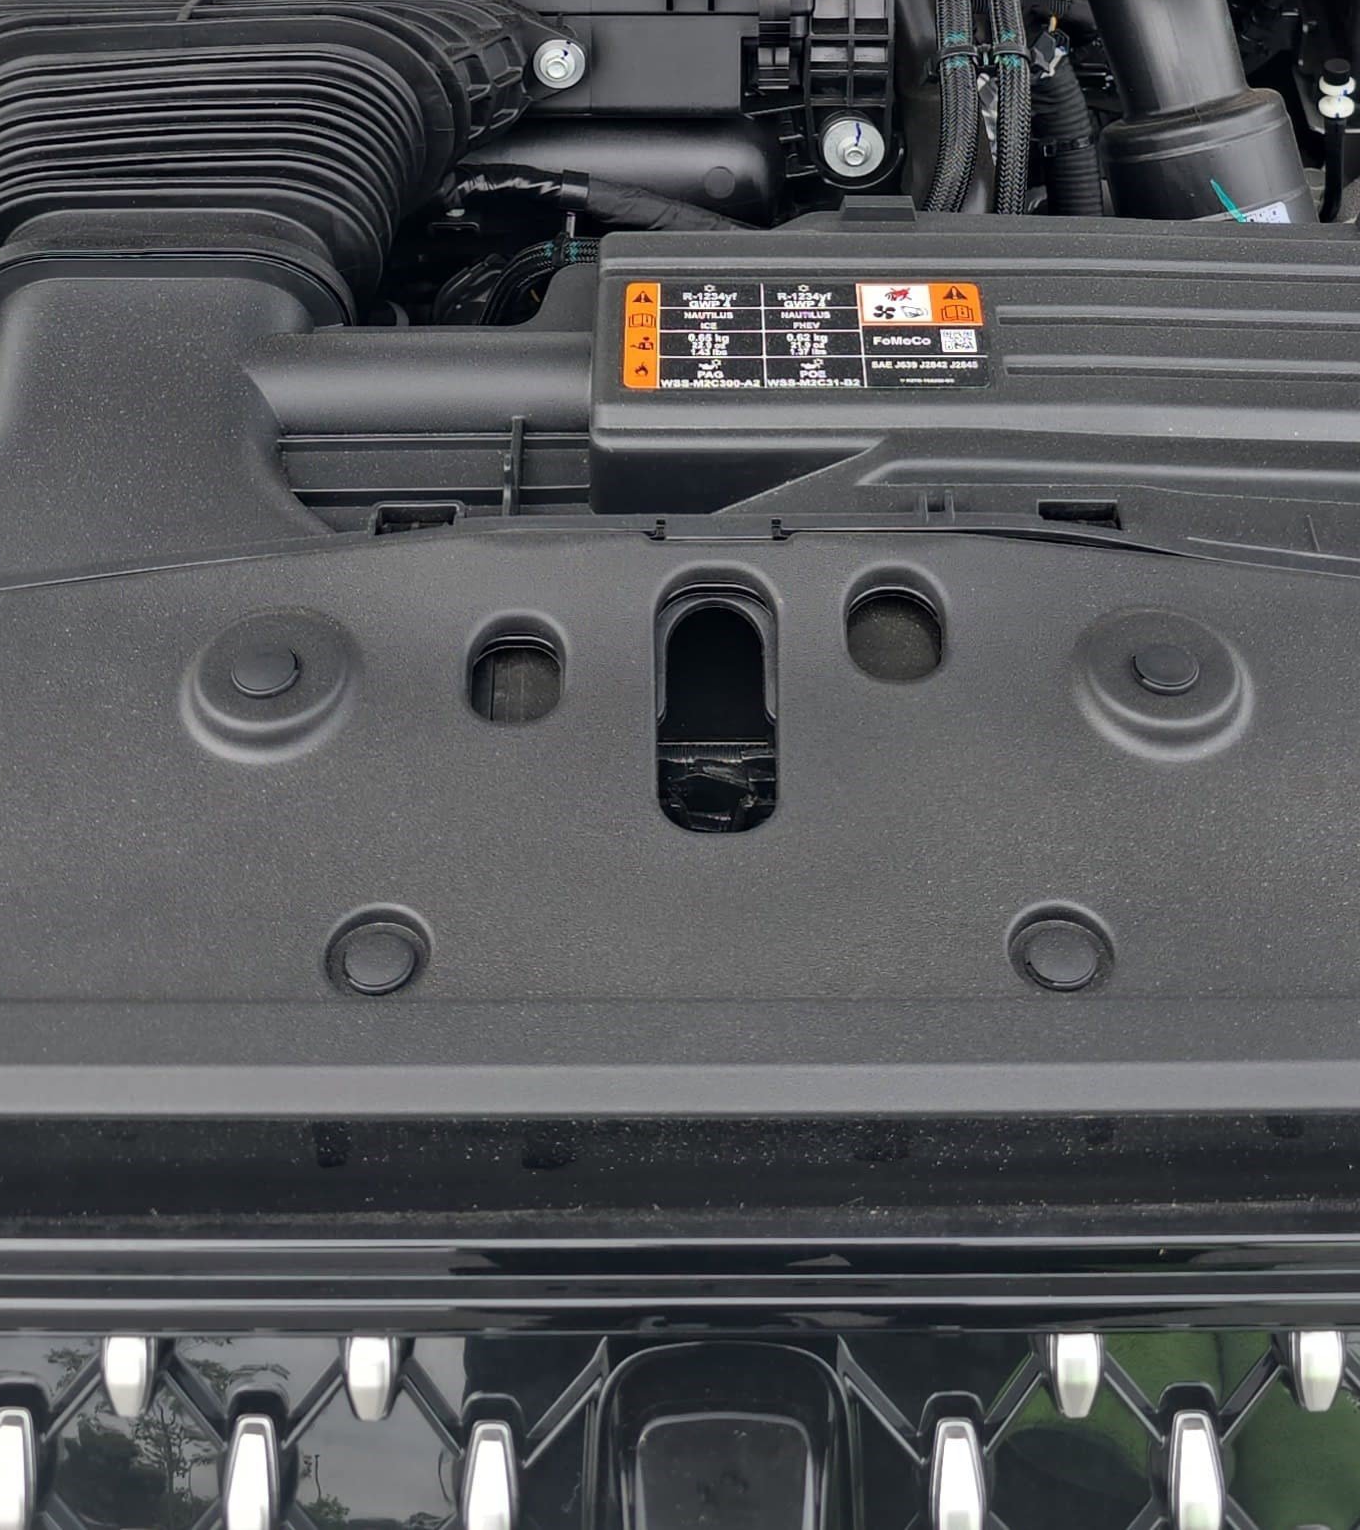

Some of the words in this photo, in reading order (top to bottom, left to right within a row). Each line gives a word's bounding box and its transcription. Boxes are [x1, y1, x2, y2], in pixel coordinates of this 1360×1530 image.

[682, 292, 738, 302] R-1234yf
[777, 292, 832, 302] R-1234yf
[689, 300, 721, 308] GWP
[784, 300, 815, 308] GWP
[684, 311, 734, 319] NAUTILUS
[780, 311, 831, 319] NAUTILUS
[700, 322, 718, 330] ICE
[715, 333, 730, 344] kg
[813, 333, 828, 344] kg
[872, 336, 931, 346] FoMoCo
[871, 361, 893, 369] SAE
[799, 370, 827, 378] POE
